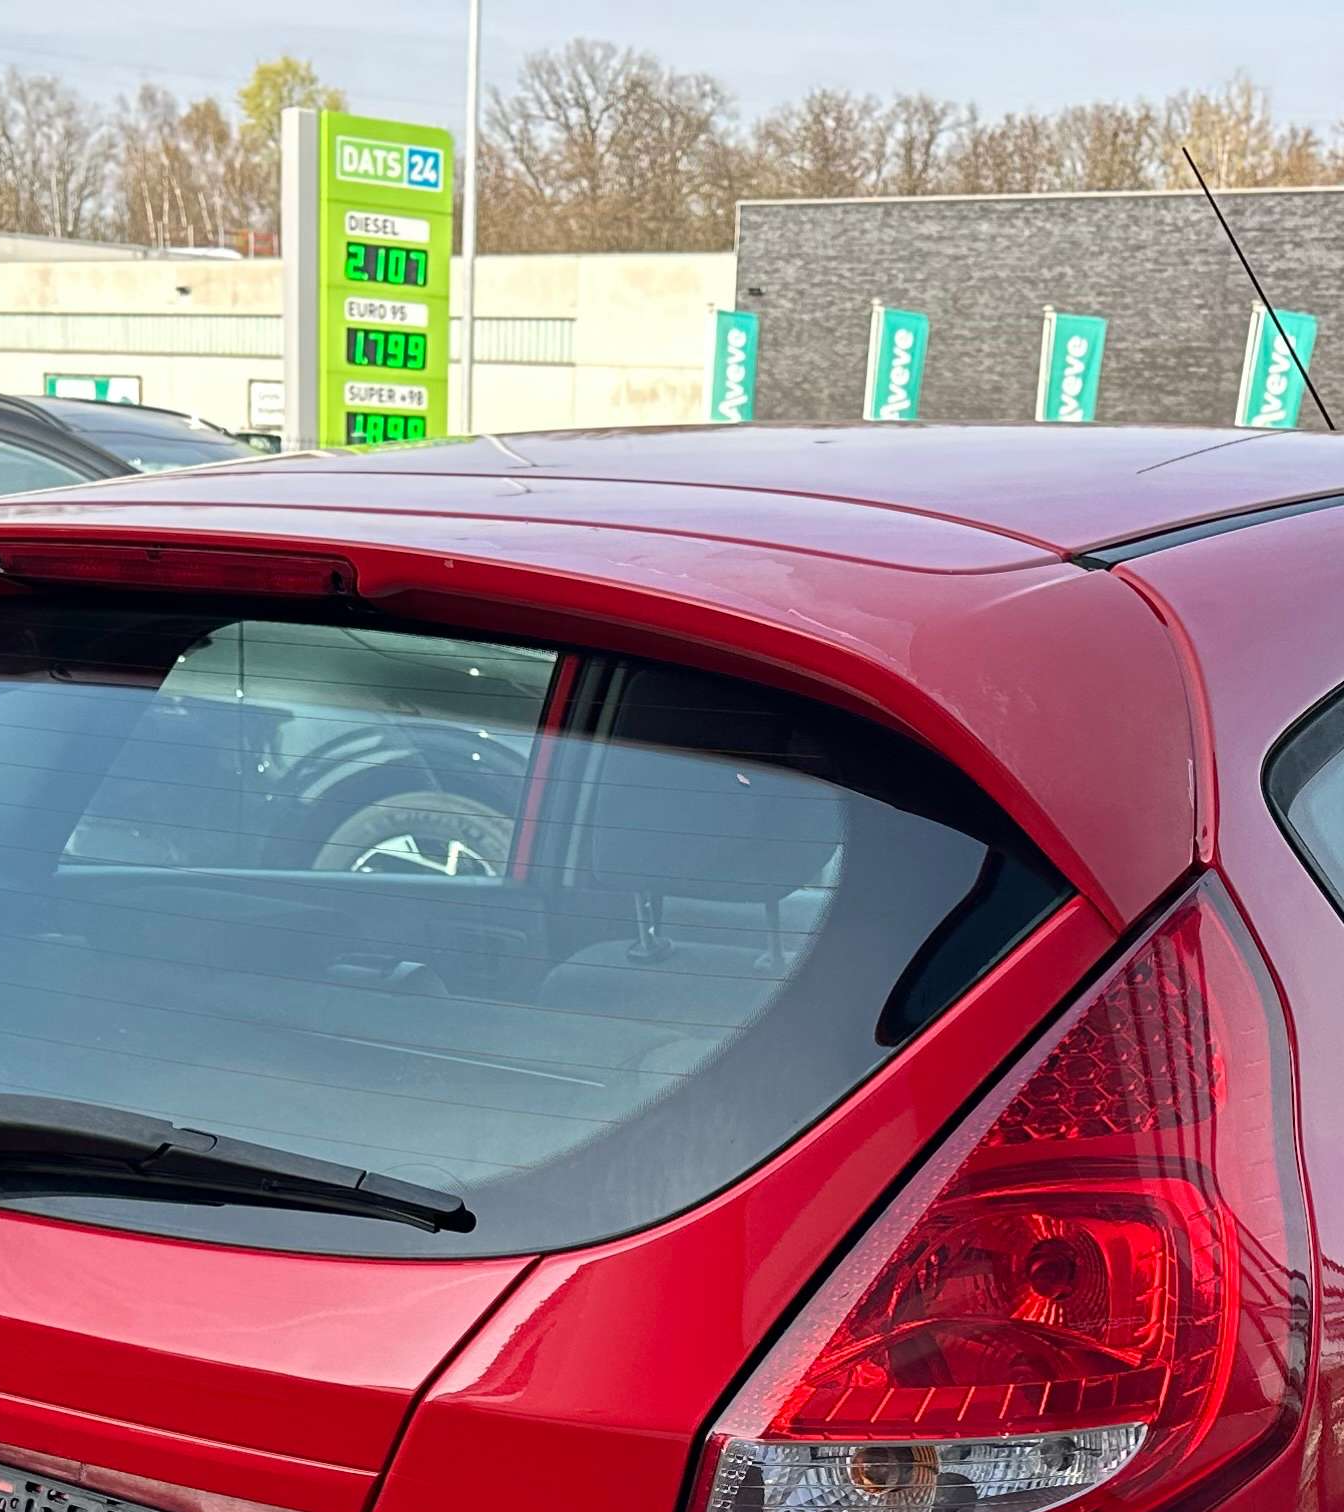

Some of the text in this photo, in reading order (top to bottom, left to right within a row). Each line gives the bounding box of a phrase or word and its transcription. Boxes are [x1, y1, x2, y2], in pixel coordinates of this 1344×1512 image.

[342, 144, 437, 183] DATS 24
[348, 214, 399, 236] DIESEL
[345, 244, 427, 286] 2.107
[348, 300, 408, 322] EURO 95
[354, 330, 427, 370] 1.799
[348, 385, 396, 404] SUPER
[718, 328, 748, 422] Aveve
[1058, 335, 1089, 422] veve
